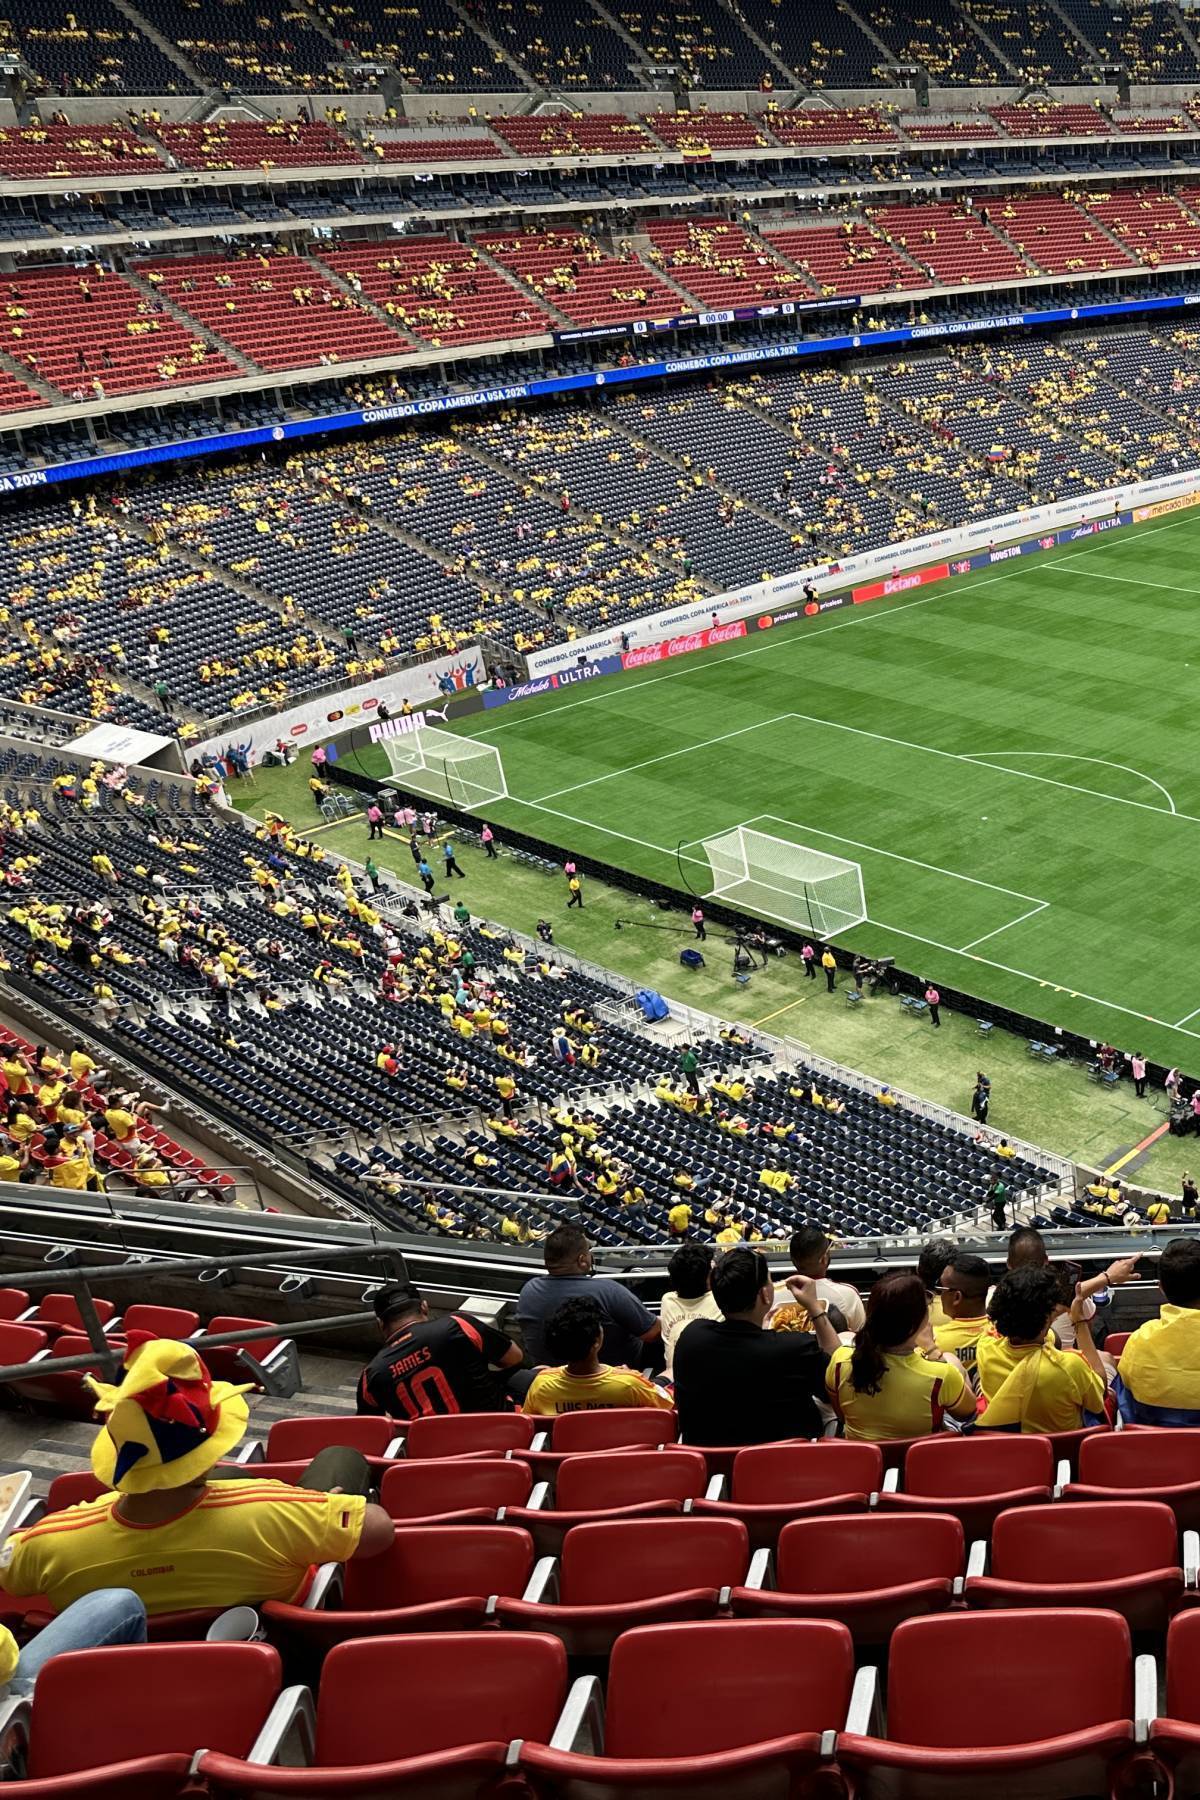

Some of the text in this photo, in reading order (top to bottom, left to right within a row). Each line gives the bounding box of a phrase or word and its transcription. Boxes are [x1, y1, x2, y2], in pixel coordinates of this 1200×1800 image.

[665, 344, 798, 373] CONMEBOL COPA AMERICA USA 2024
[362, 386, 528, 423] CONMEBOL COPA AMERICA USA 2024
[15, 470, 48, 488] 2024
[1152, 495, 1197, 515] mercado libre
[1098, 517, 1122, 531] ULTRA
[990, 545, 1021, 562] HOUSTON
[883, 574, 922, 594] Betano
[659, 613, 690, 628] CONMEBOL
[690, 608, 705, 618] COPA
[705, 602, 729, 613] AMERICA
[820, 598, 843, 610] priceless
[774, 610, 798, 625] priceless
[534, 653, 568, 668] CONMEBOL
[568, 647, 585, 657] COPA
[585, 639, 612, 652] AMERICA
[508, 664, 601, 701] Michelob ULTRA
[368, 711, 426, 744] PUMA
[390, 1345, 432, 1380] JAMES
[396, 1366, 461, 1421] 10
[130, 1564, 176, 1578] COLOMBIA
